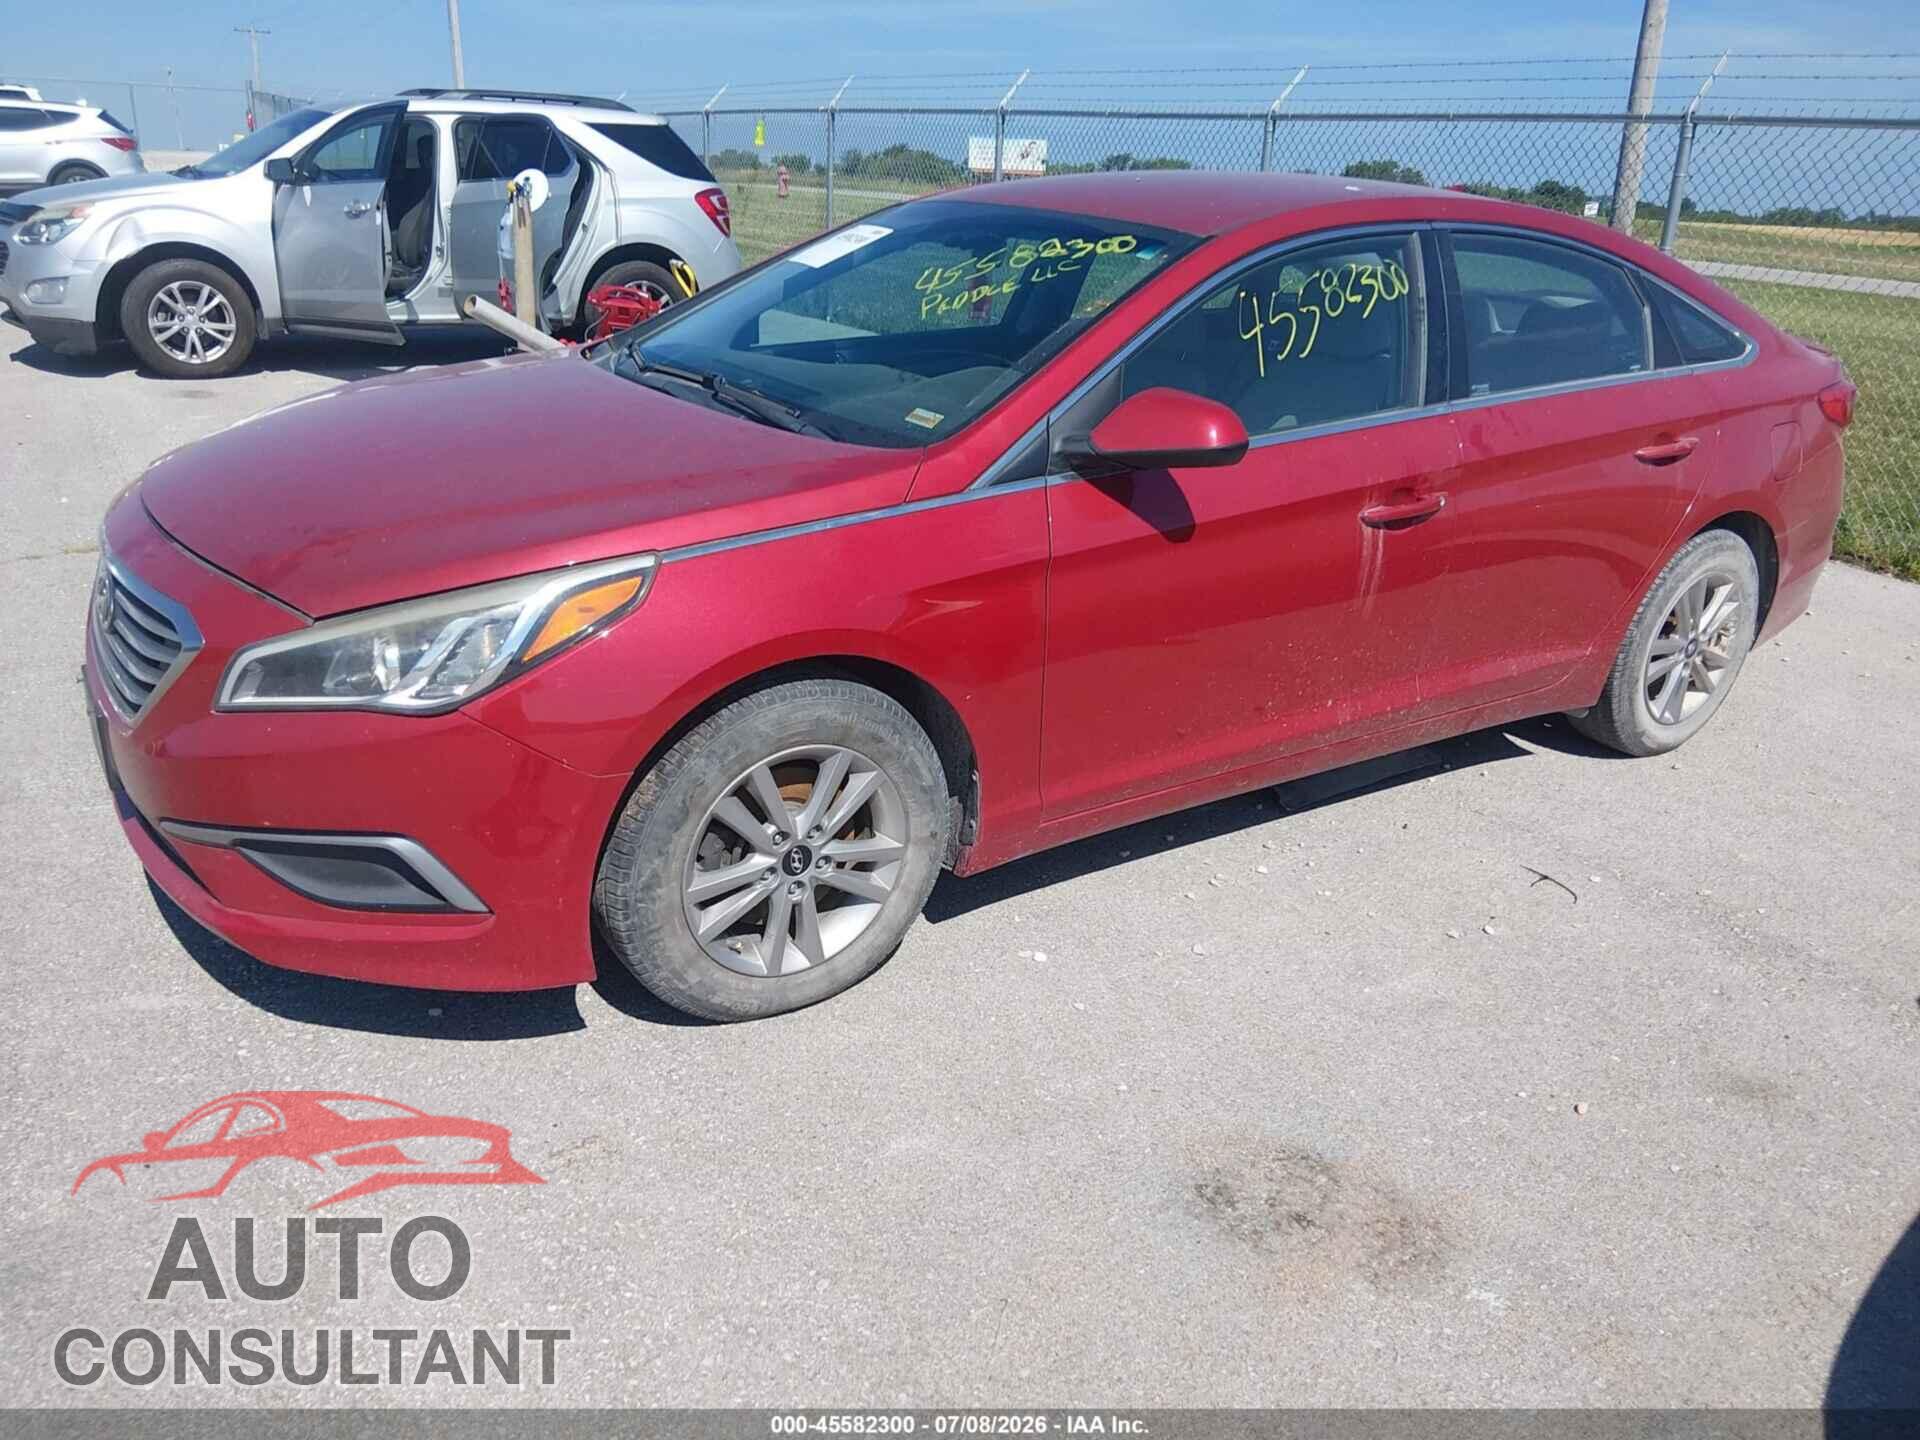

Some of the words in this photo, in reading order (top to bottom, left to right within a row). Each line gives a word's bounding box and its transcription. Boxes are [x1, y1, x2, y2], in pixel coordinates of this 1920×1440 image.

[914, 235, 1137, 294] 45582300
[1030, 259, 1082, 283] LLC
[1238, 258, 1409, 378] 45582300
